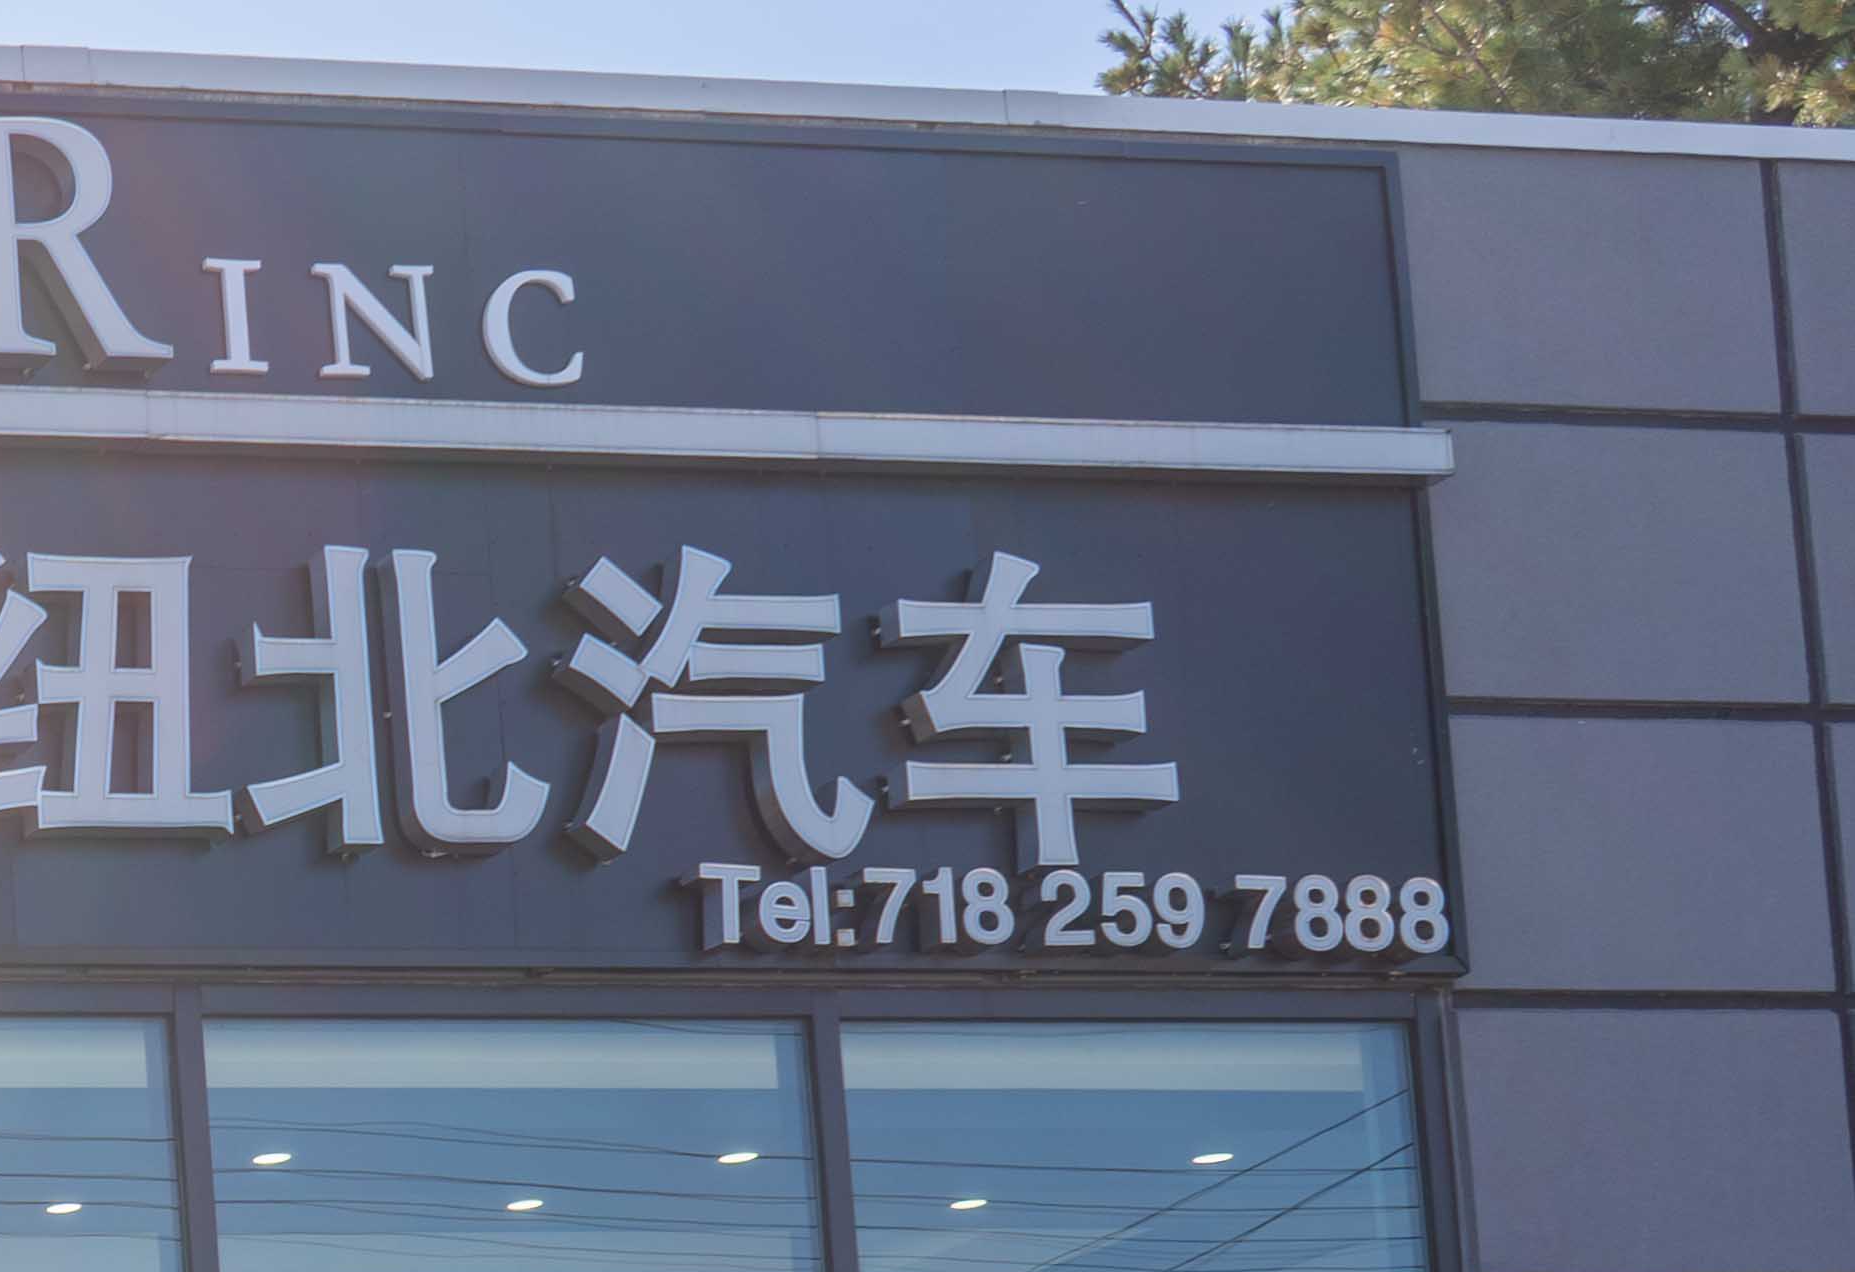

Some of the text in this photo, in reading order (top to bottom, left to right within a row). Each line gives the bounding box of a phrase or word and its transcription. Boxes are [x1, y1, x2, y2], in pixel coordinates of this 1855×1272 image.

[202, 257, 586, 387] INC
[1040, 868, 1206, 950] 259
[1234, 874, 1451, 954] 7888
